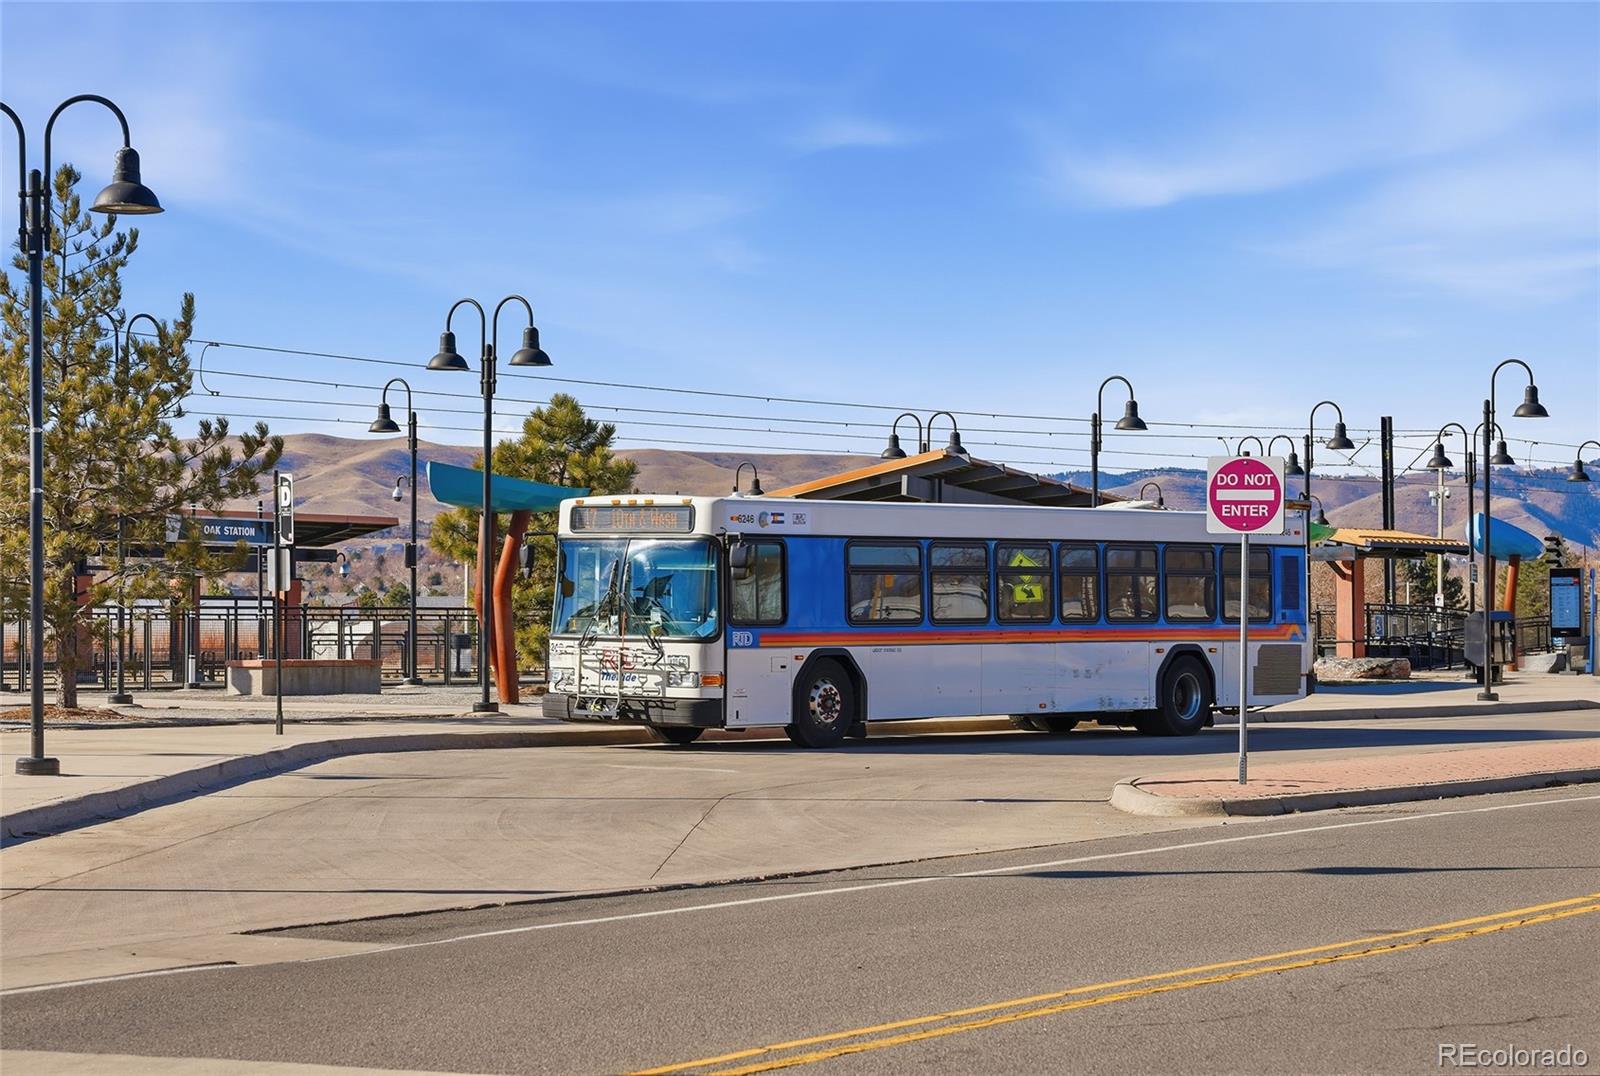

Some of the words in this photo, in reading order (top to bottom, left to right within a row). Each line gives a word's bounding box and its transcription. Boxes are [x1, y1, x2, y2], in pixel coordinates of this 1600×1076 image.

[1217, 473, 1239, 486] DO
[1244, 473, 1273, 486] NOT
[1221, 505, 1269, 517] ENTER
[737, 514, 755, 524] 6246
[203, 525, 221, 535] OAK
[223, 526, 256, 537] STATION
[732, 631, 753, 647] RTD
